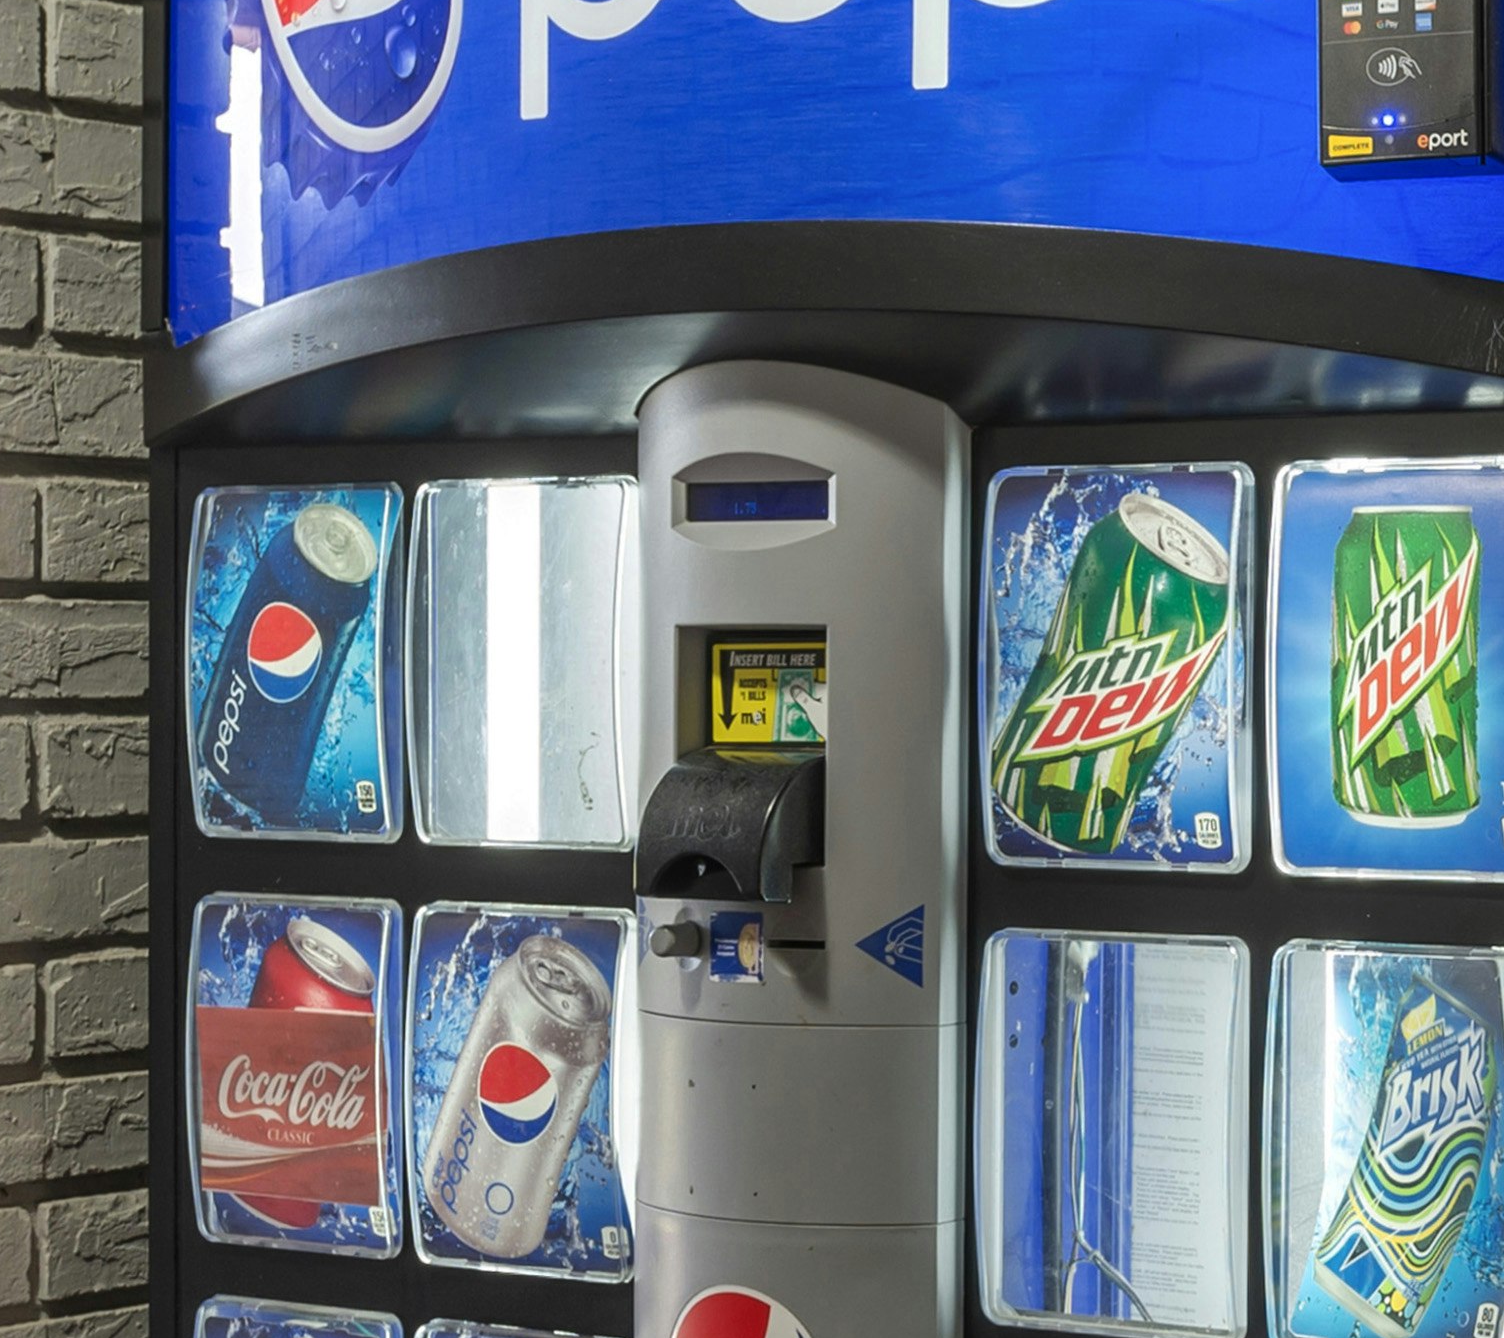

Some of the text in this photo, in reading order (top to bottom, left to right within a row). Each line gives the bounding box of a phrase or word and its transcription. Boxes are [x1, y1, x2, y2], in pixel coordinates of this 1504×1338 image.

[1417, 129, 1468, 150] eport
[730, 651, 816, 667] INSERT BILL HERE
[1354, 581, 1426, 670] Mtn
[1051, 639, 1163, 697] Mtn
[213, 670, 248, 775] pepsi
[218, 1054, 371, 1131] Coca-Cola
[267, 1128, 315, 1146] CLASSIC
[441, 1109, 477, 1215] pepsi
